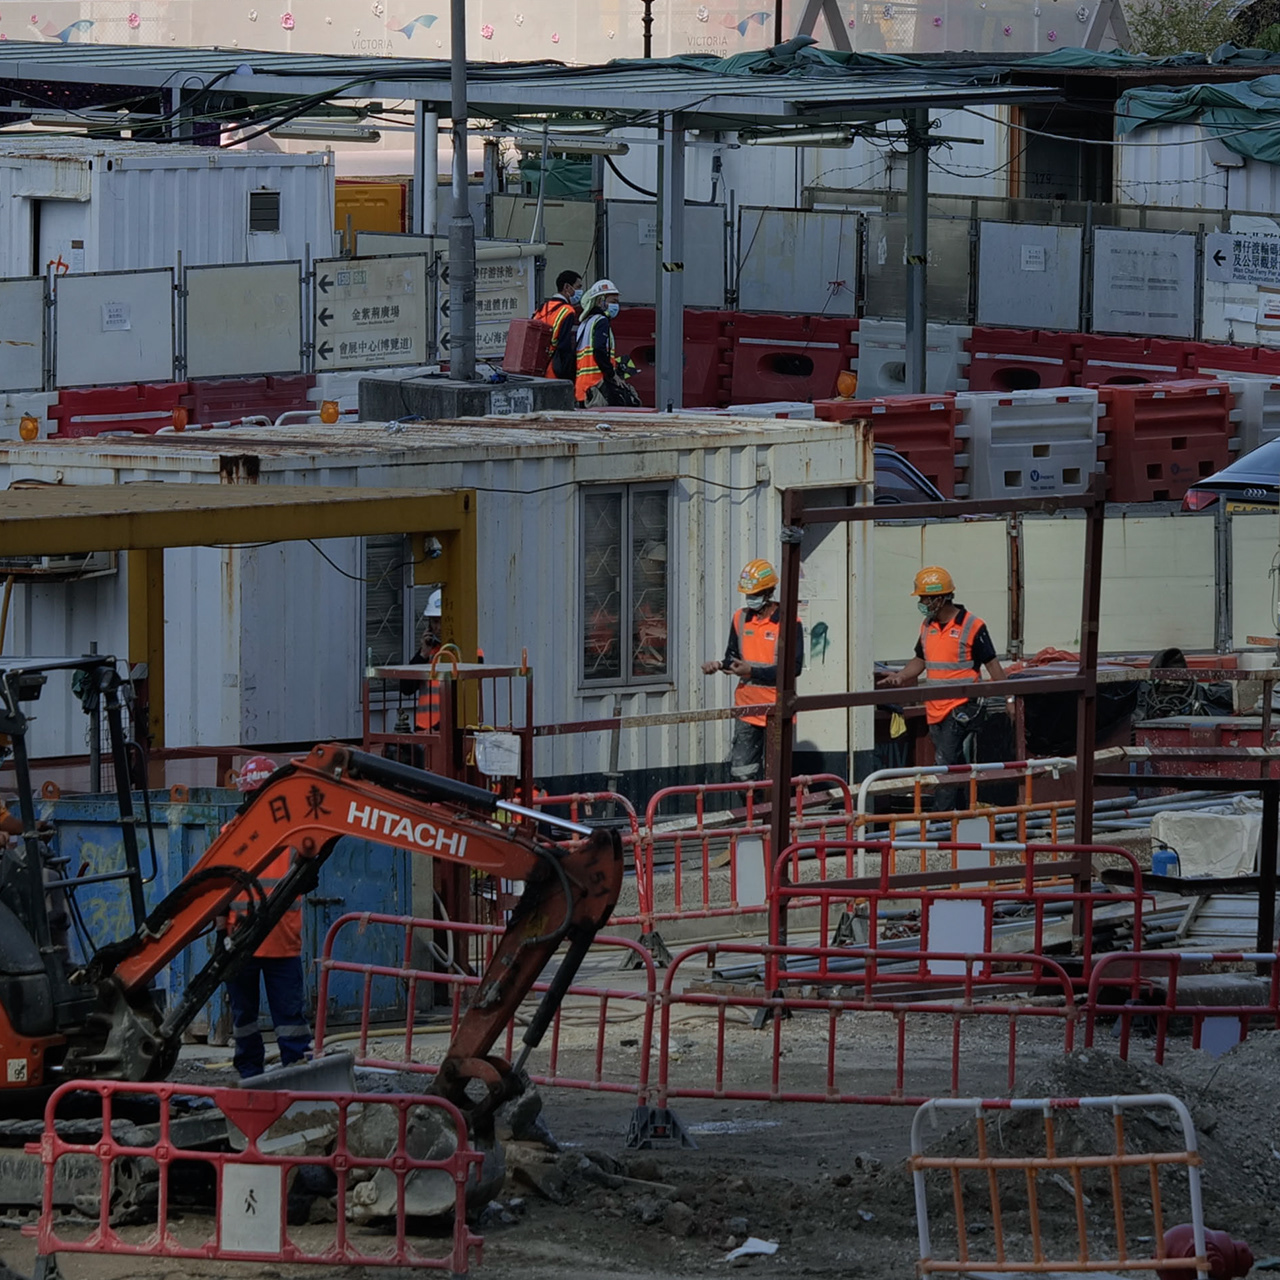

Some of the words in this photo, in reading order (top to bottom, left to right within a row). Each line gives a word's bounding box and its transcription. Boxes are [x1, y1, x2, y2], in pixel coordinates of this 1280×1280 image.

[352, 39, 393, 50] VICTORIA
[687, 36, 728, 47] VICTORIA
[346, 801, 468, 858] HITACHI
